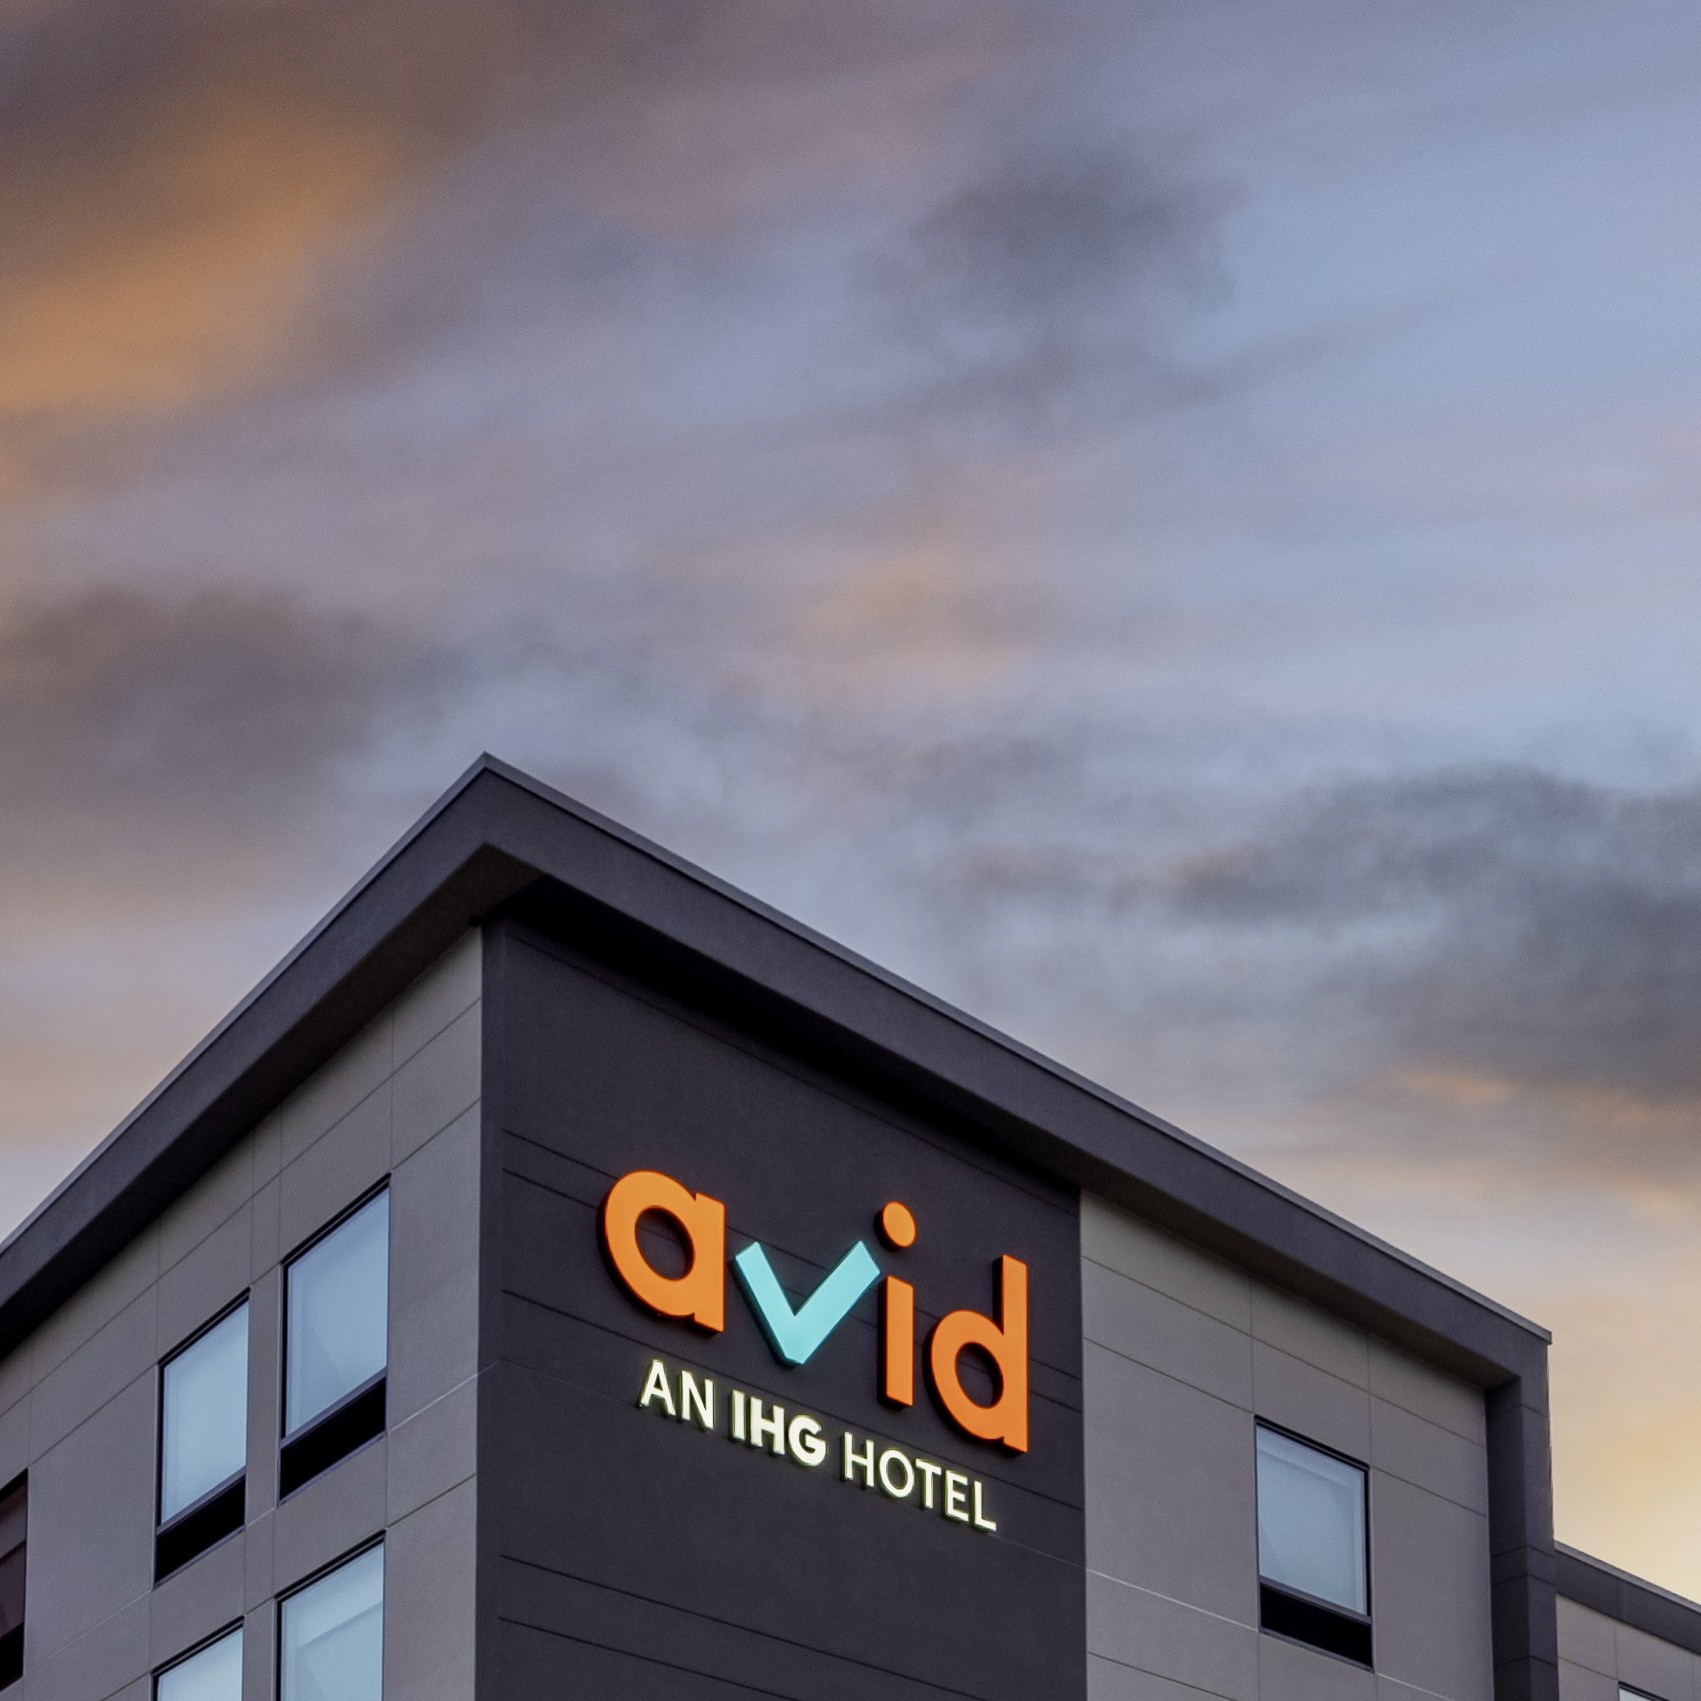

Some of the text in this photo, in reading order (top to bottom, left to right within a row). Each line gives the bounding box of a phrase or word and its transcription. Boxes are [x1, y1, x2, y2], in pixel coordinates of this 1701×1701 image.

[601, 1170, 1029, 1454] avid
[639, 1358, 997, 1533] AN IHG HOTEL
